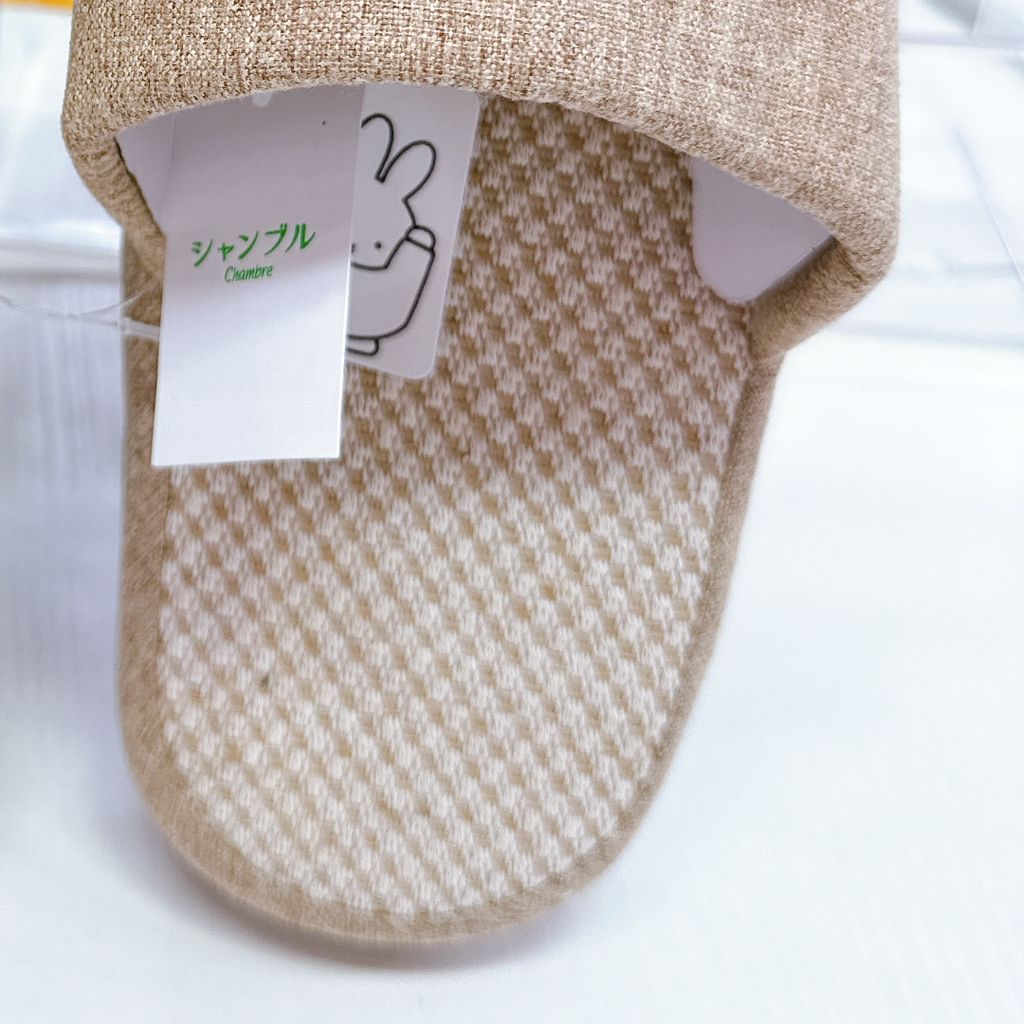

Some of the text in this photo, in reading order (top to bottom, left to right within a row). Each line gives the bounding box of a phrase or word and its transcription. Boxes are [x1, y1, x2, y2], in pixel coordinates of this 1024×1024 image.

[191, 222, 316, 267] シャンブル
[224, 264, 274, 283] Chambre
